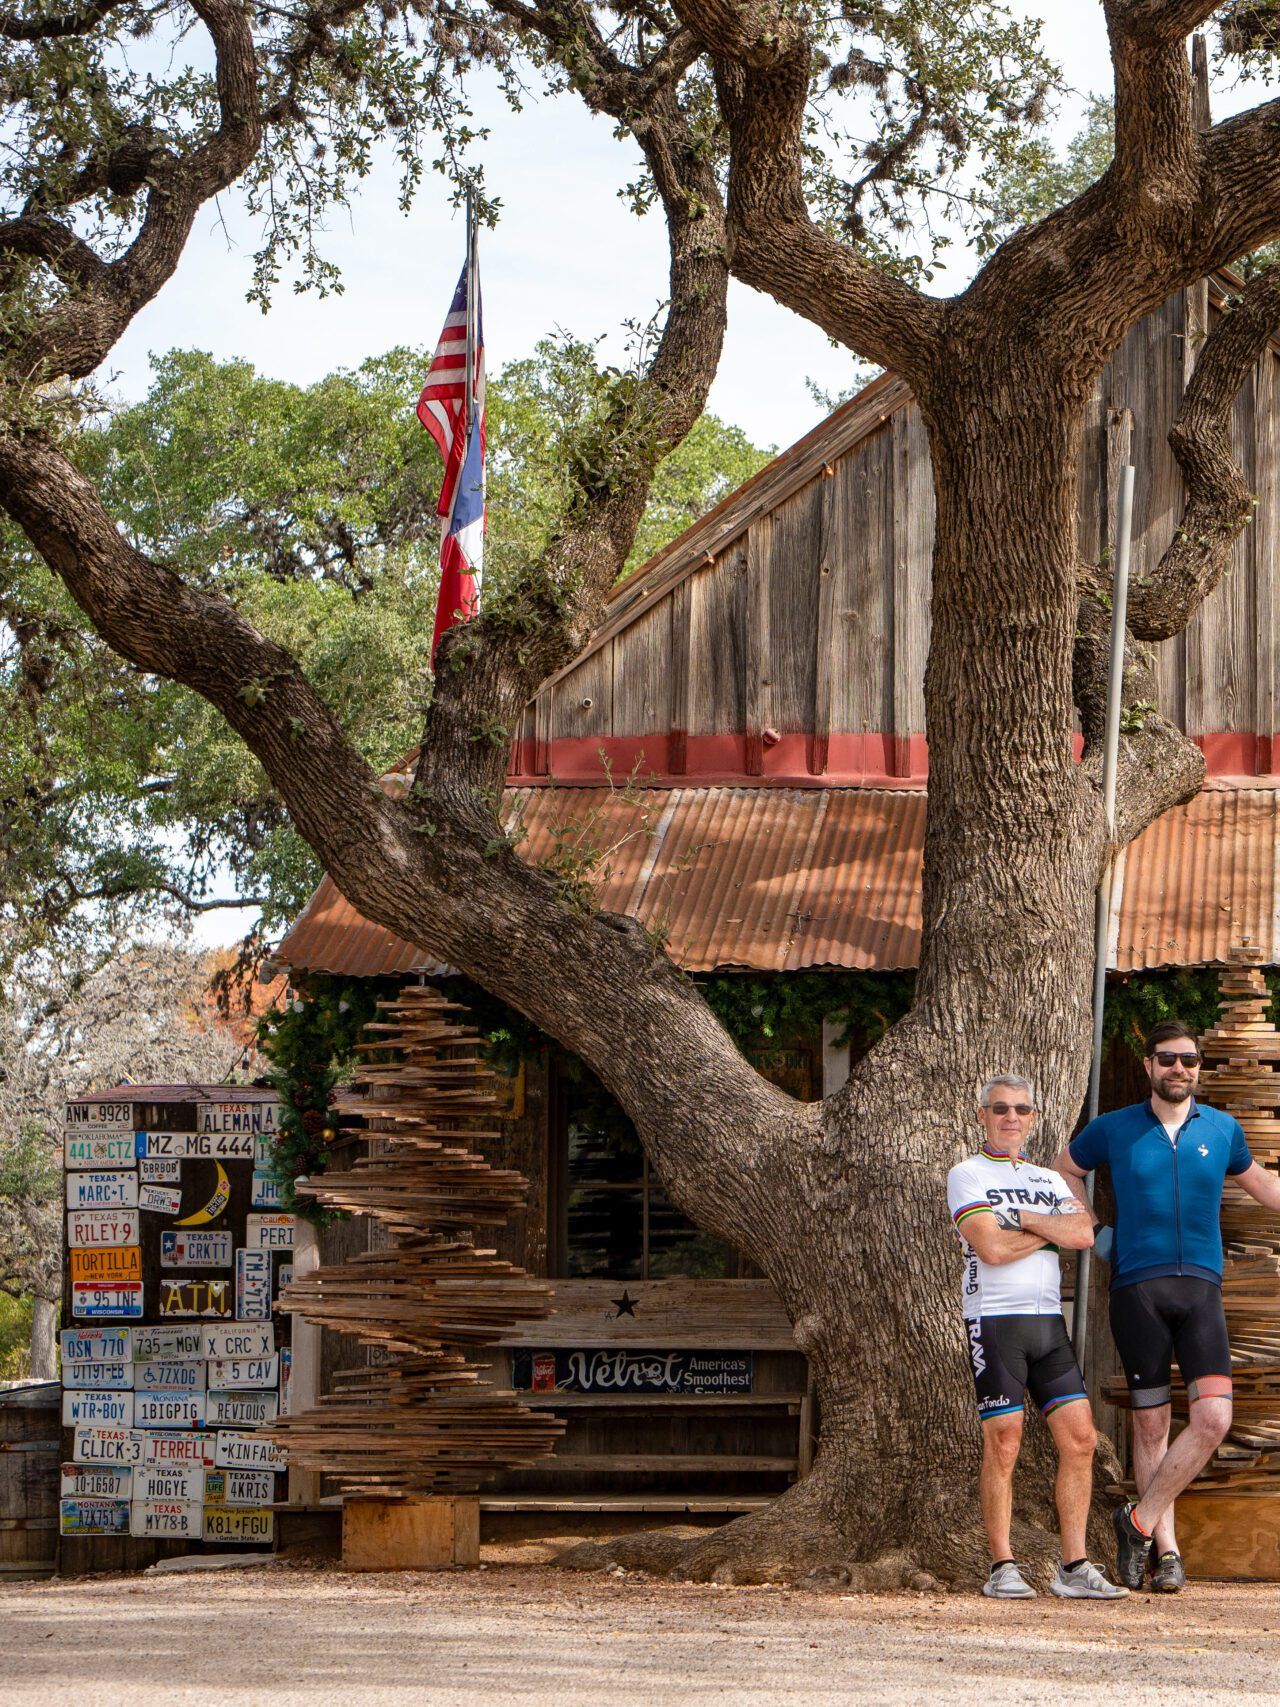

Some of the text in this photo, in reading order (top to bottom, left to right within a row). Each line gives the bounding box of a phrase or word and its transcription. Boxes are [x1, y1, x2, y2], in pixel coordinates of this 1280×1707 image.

[99, 1105, 130, 1121] 9928
[219, 1105, 247, 1113] TEXAS
[204, 1114, 260, 1132] ALEMAN
[69, 1142, 132, 1159] 441 CTZ
[147, 1136, 173, 1154] MZ
[186, 1136, 211, 1154] MG
[217, 1137, 252, 1155] 444
[89, 1174, 117, 1182] TEXAS
[79, 1185, 110, 1201] MARC
[74, 1212, 135, 1222] 19 TEXAS 77
[189, 1243, 228, 1260] CRKTT
[75, 1252, 138, 1271] TORTILLA
[94, 1290, 139, 1308] 95 INF
[166, 1284, 225, 1313] ATM
[245, 1289, 263, 1317] 314
[100, 1339, 124, 1356] 770
[135, 1336, 200, 1354] 735 MGV
[208, 1336, 269, 1355] X CRC X
[965, 1318, 987, 1378] TRAVA
[232, 1361, 271, 1380] 5 CAV
[690, 1357, 746, 1371] America's
[683, 1372, 750, 1386] Smoothest
[85, 1393, 112, 1401] TEXAS
[72, 1402, 126, 1419] WTR BOY
[142, 1403, 197, 1420] 1BIGPIG
[217, 1403, 266, 1420] REVIOUS
[96, 1430, 125, 1440] TEXAS
[152, 1440, 208, 1460] TERRELL
[156, 1469, 183, 1477] TEXAS
[148, 1479, 188, 1497] HOGYE
[230, 1481, 268, 1499] 4KRIS
[154, 1504, 182, 1514] TEXAS
[206, 1516, 268, 1534] K81 FGU
